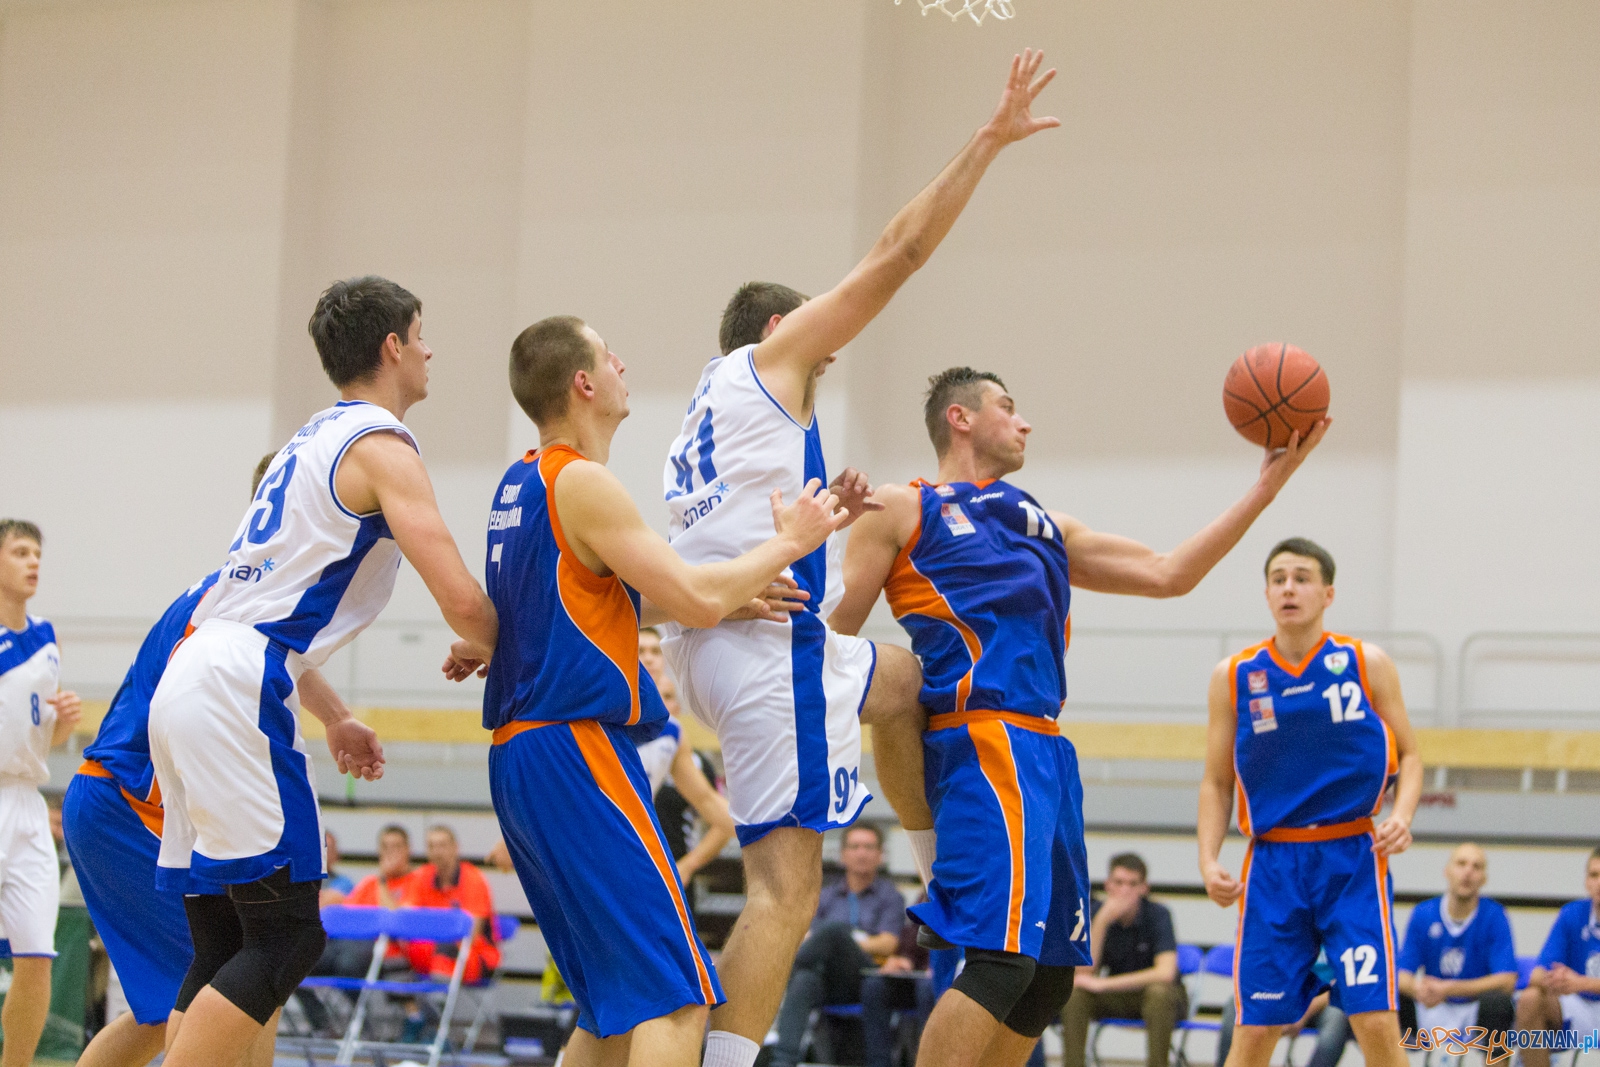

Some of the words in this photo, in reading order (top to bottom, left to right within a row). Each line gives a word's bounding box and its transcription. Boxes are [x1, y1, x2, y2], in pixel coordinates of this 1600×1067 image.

[30, 692, 40, 727] 8
[1322, 681, 1366, 724] 12
[1340, 945, 1379, 987] 12
